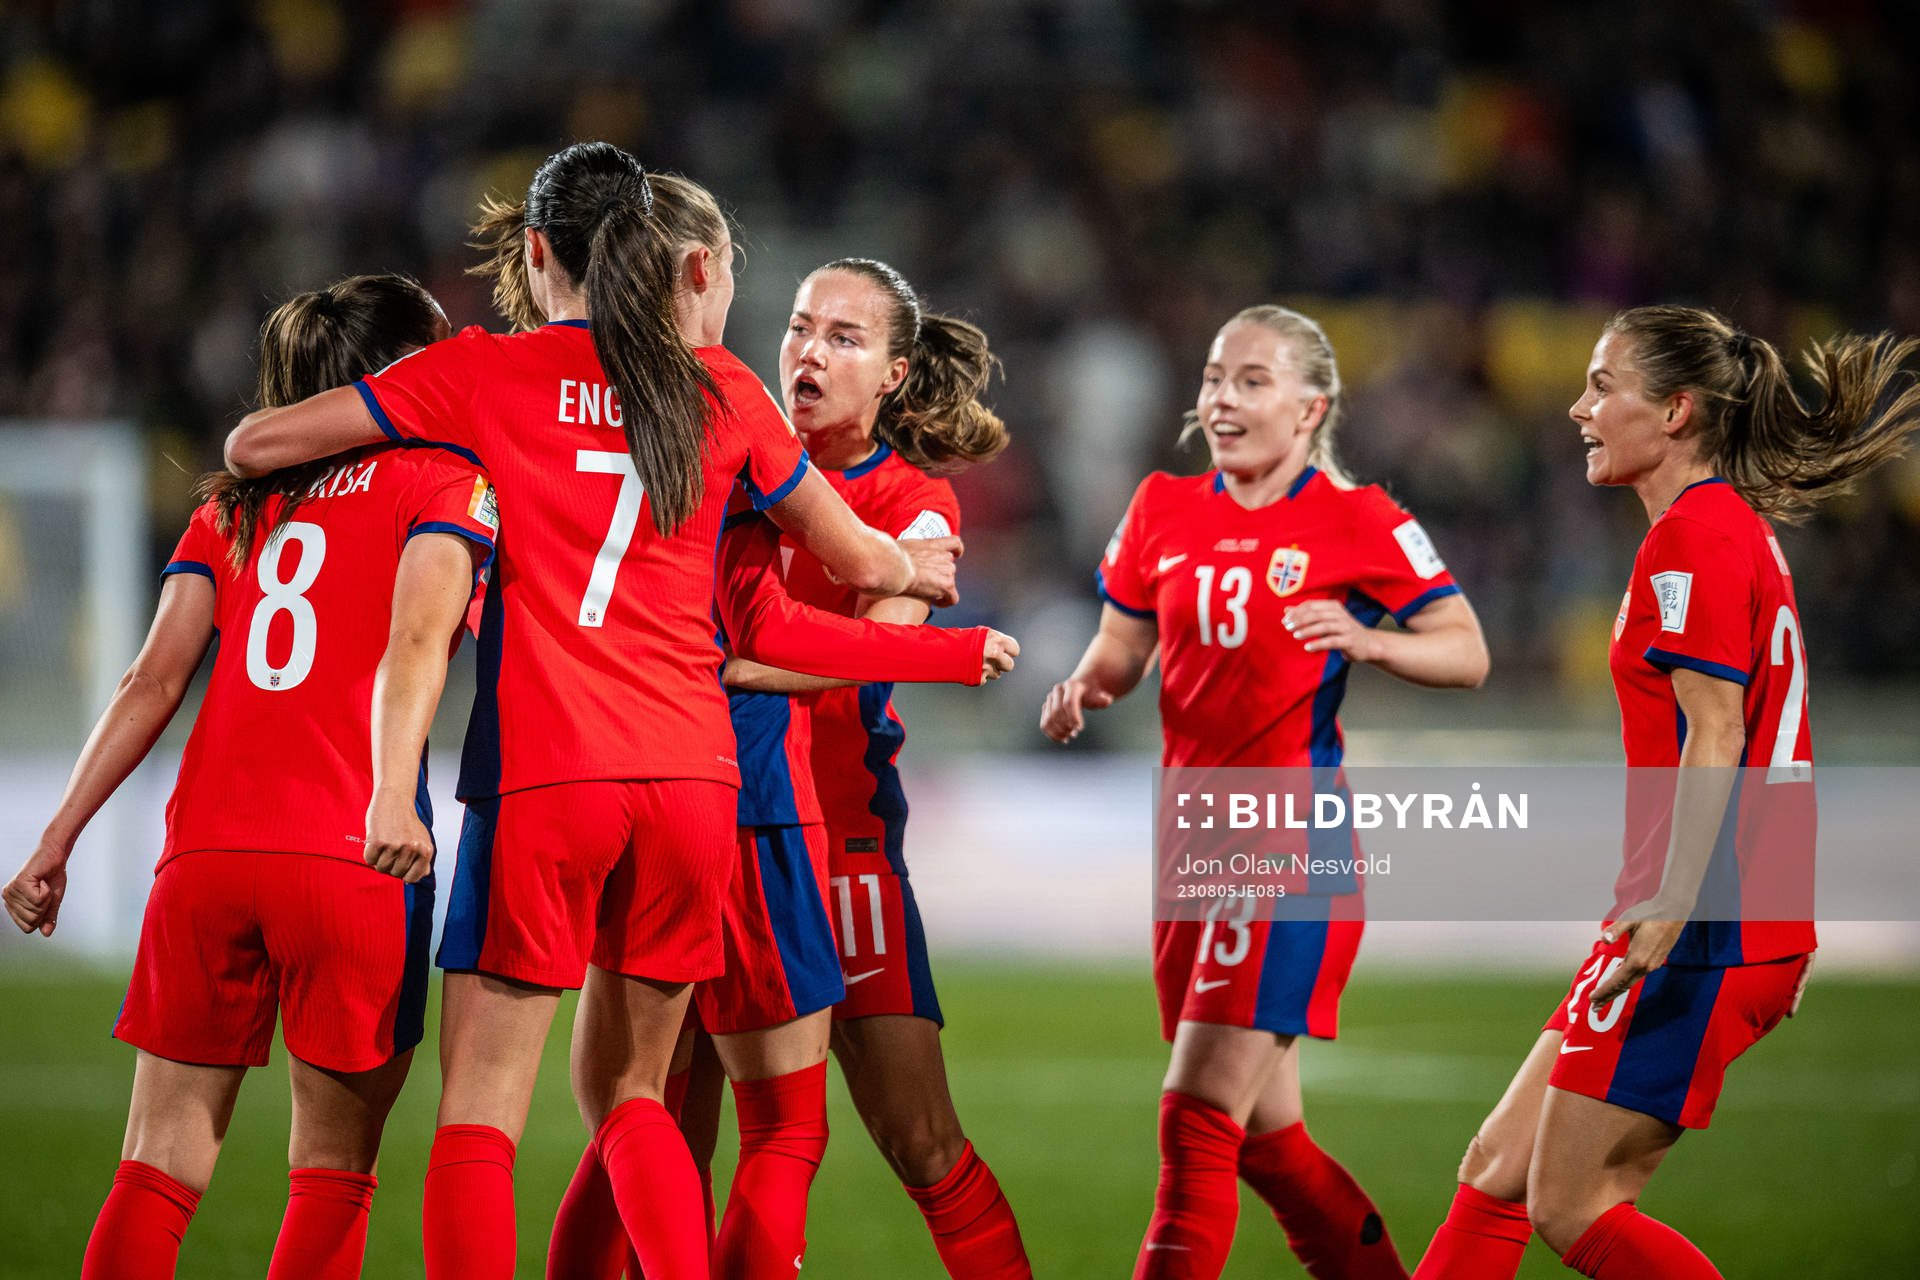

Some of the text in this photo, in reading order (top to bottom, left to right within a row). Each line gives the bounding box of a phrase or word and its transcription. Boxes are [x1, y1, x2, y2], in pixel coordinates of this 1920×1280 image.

[559, 379, 624, 427] ENG
[576, 449, 645, 627] 7
[246, 521, 326, 691] 8
[1194, 565, 1253, 649] 13
[1765, 605, 1813, 784] 2
[830, 874, 886, 957] 11
[1198, 891, 1257, 967] 13
[1567, 954, 1630, 1033] 20
